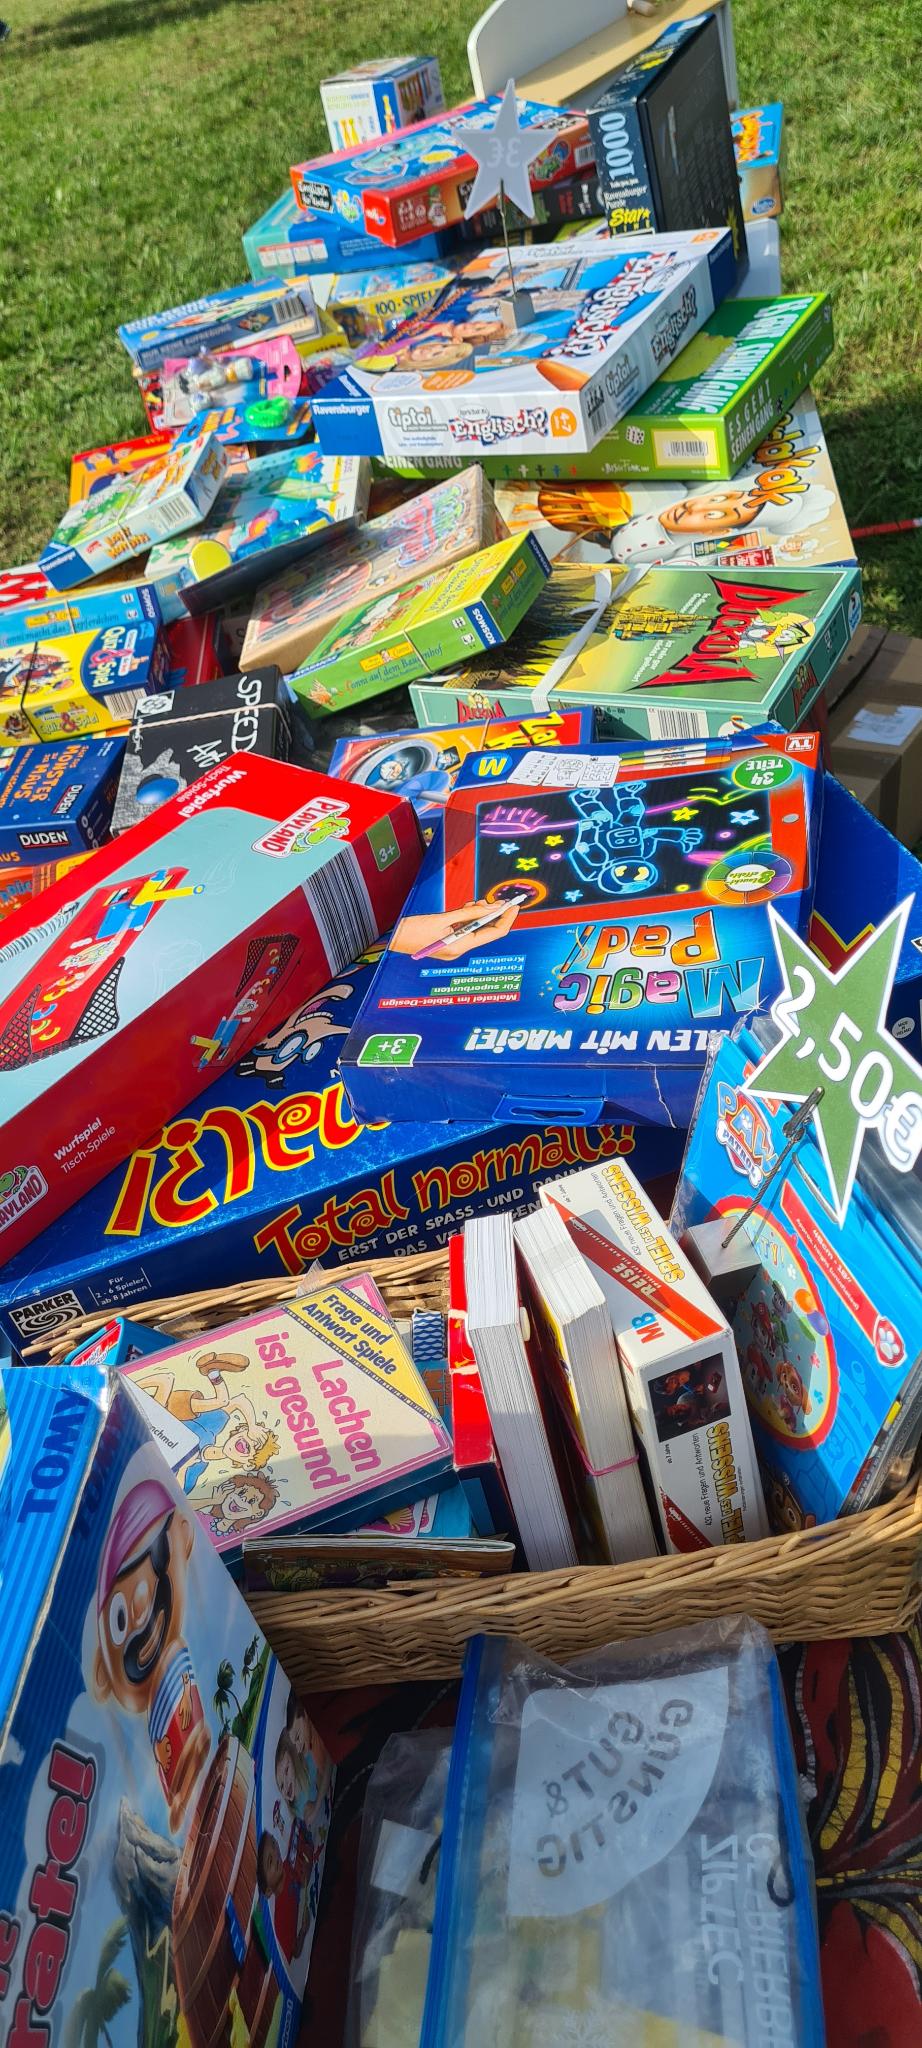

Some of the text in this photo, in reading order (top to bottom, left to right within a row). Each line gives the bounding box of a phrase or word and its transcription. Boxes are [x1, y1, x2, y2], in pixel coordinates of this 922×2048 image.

[599, 112, 635, 180] 1000
[313, 403, 371, 416] Ravensburger
[387, 404, 434, 433] tiptoi
[453, 407, 546, 442] Englisch?
[141, 587, 156, 618] KOSMOS
[471, 607, 497, 645] KOSMOS
[383, 662, 401, 679] dem
[186, 739, 228, 768] Art
[788, 737, 813, 750] TV
[29, 743, 82, 803] MONSTER
[176, 765, 231, 804] Tisch-Spiele
[750, 771, 775, 786] 34
[53, 783, 84, 815] DUDEN
[178, 769, 248, 819] Wurfspiel
[19, 831, 69, 847] DUDEN
[261, 798, 336, 855] PLAYLAND
[378, 843, 397, 864] 3+
[588, 910, 720, 968] Pad
[432, 966, 483, 975] Phantasie
[471, 956, 525, 965] Kreativität
[485, 964, 523, 972] Fördert
[433, 984, 500, 994] superbunten
[452, 974, 522, 985] Zeichenspaß
[553, 957, 765, 1019] Magic
[382, 996, 454, 1007] Tablet-Design
[473, 993, 518, 1003] Maltafel
[377, 1038, 407, 1055] 3+
[772, 964, 922, 1168] 2,50€
[53, 1117, 103, 1162] Wurfspiel
[60, 1124, 117, 1175] Tisch-Spiele
[0, 1176, 44, 1232] AYLAND
[601, 1163, 653, 1231] WISSENS
[253, 1169, 411, 1276] Total
[337, 1236, 379, 1262] ERST
[386, 1224, 419, 1245] DER
[425, 1204, 475, 1231] SPASS
[486, 1188, 525, 1208] UND
[393, 1240, 428, 1258] DAS
[645, 1235, 686, 1285] SPIEL
[107, 1274, 125, 1285] Für
[115, 1276, 145, 1294] Spieler
[119, 1284, 148, 1302] Jahren
[611, 1263, 658, 1297] REISE
[12, 1290, 77, 1323] PARKER
[322, 1293, 395, 1346] Frage und
[301, 1302, 399, 1377] Antwort Spiele
[630, 1311, 668, 1345] MB
[254, 1331, 351, 1491] ist gesund
[311, 1358, 384, 1473] Lachen
[18, 1386, 87, 1526] TOMY
[705, 1421, 739, 1503] WISSENS
[8, 1742, 95, 2048] rate!
